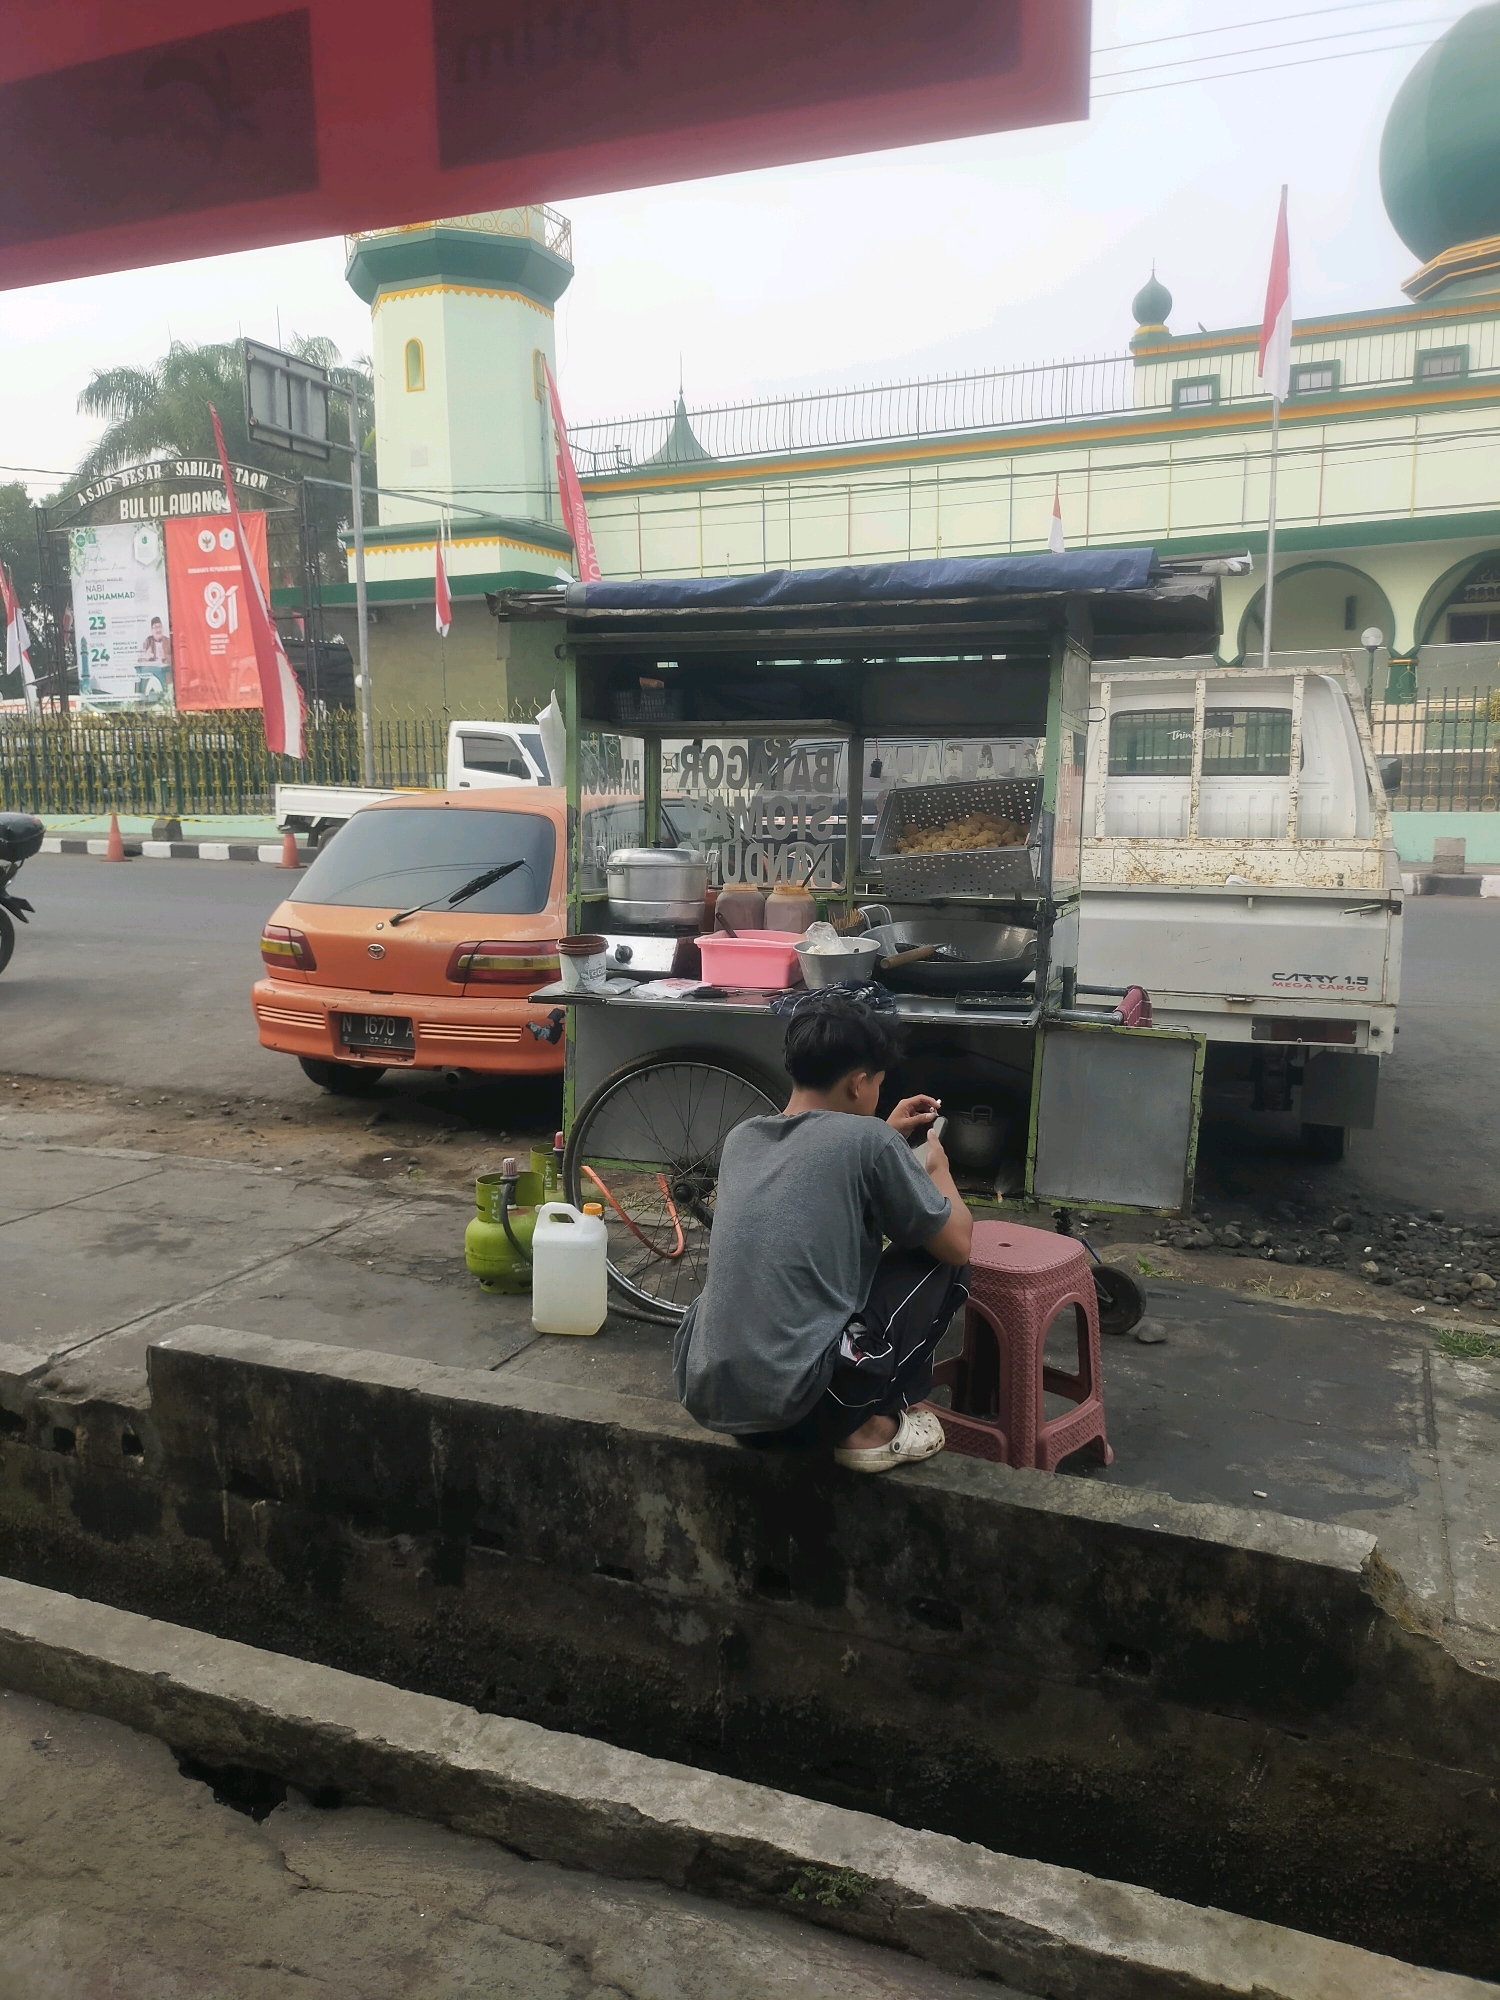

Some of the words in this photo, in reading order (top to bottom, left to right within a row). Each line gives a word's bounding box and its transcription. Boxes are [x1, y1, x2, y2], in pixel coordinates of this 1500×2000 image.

[121, 463, 163, 487] BESAR
[176, 462, 224, 480] SABILIT
[120, 490, 223, 520] BULULAWANG
[85, 584, 105, 592] NABI
[86, 592, 135, 602] MUHAMMAD
[204, 581, 239, 634] 81
[88, 616, 106, 631] 23
[91, 648, 110, 662] 24
[1167, 730, 1195, 741] Thin
[1272, 973, 1339, 984] CARRY
[1344, 975, 1369, 985] 1.5
[1318, 983, 1367, 992] CARGO
[342, 1015, 352, 1032] N
[365, 1016, 395, 1036] 1670
[369, 1036, 379, 1044] 07
